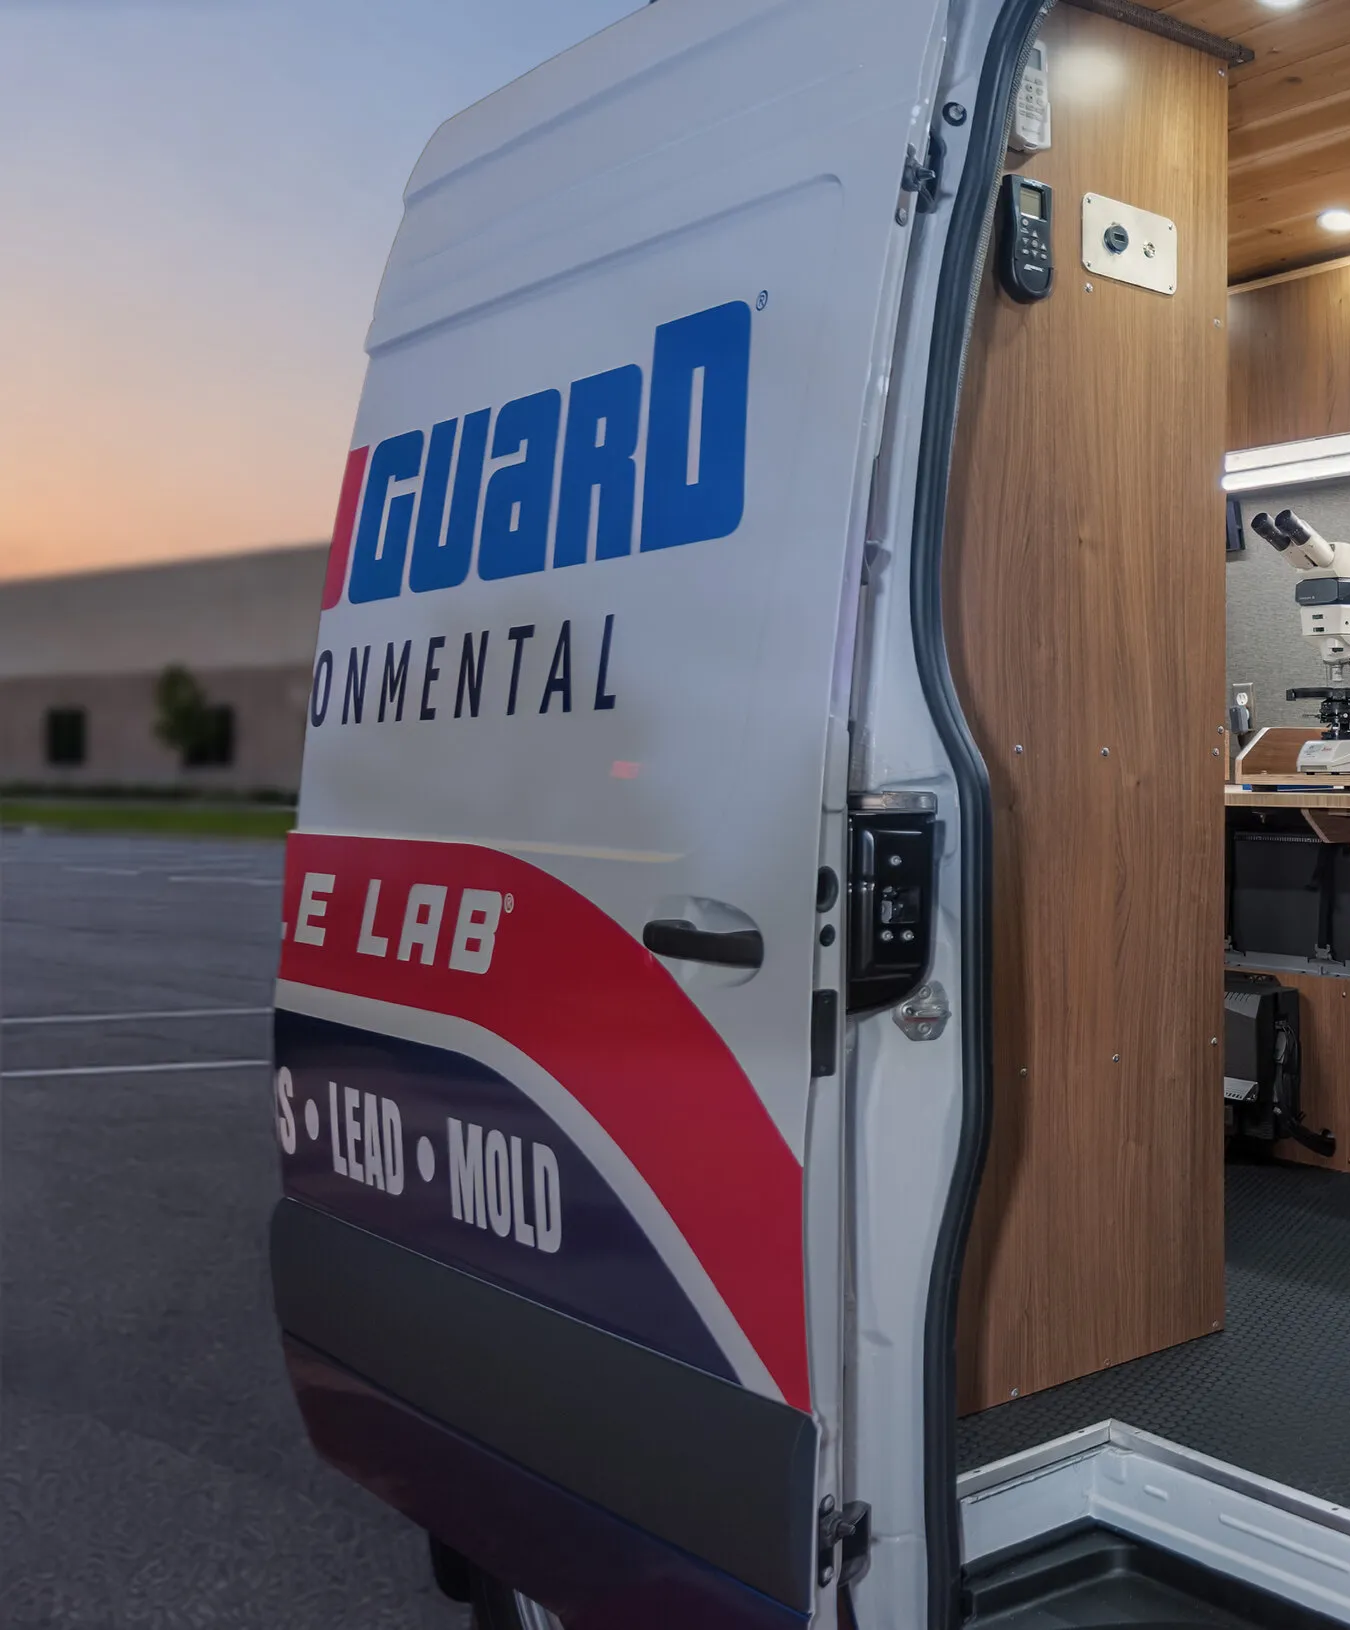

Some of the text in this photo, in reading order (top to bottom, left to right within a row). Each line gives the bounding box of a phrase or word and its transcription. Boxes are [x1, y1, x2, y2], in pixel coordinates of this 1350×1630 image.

[310, 613, 617, 727] ONMENTAL
[281, 872, 336, 947] E
[274, 1066, 562, 1254] S LEAD MOLD
